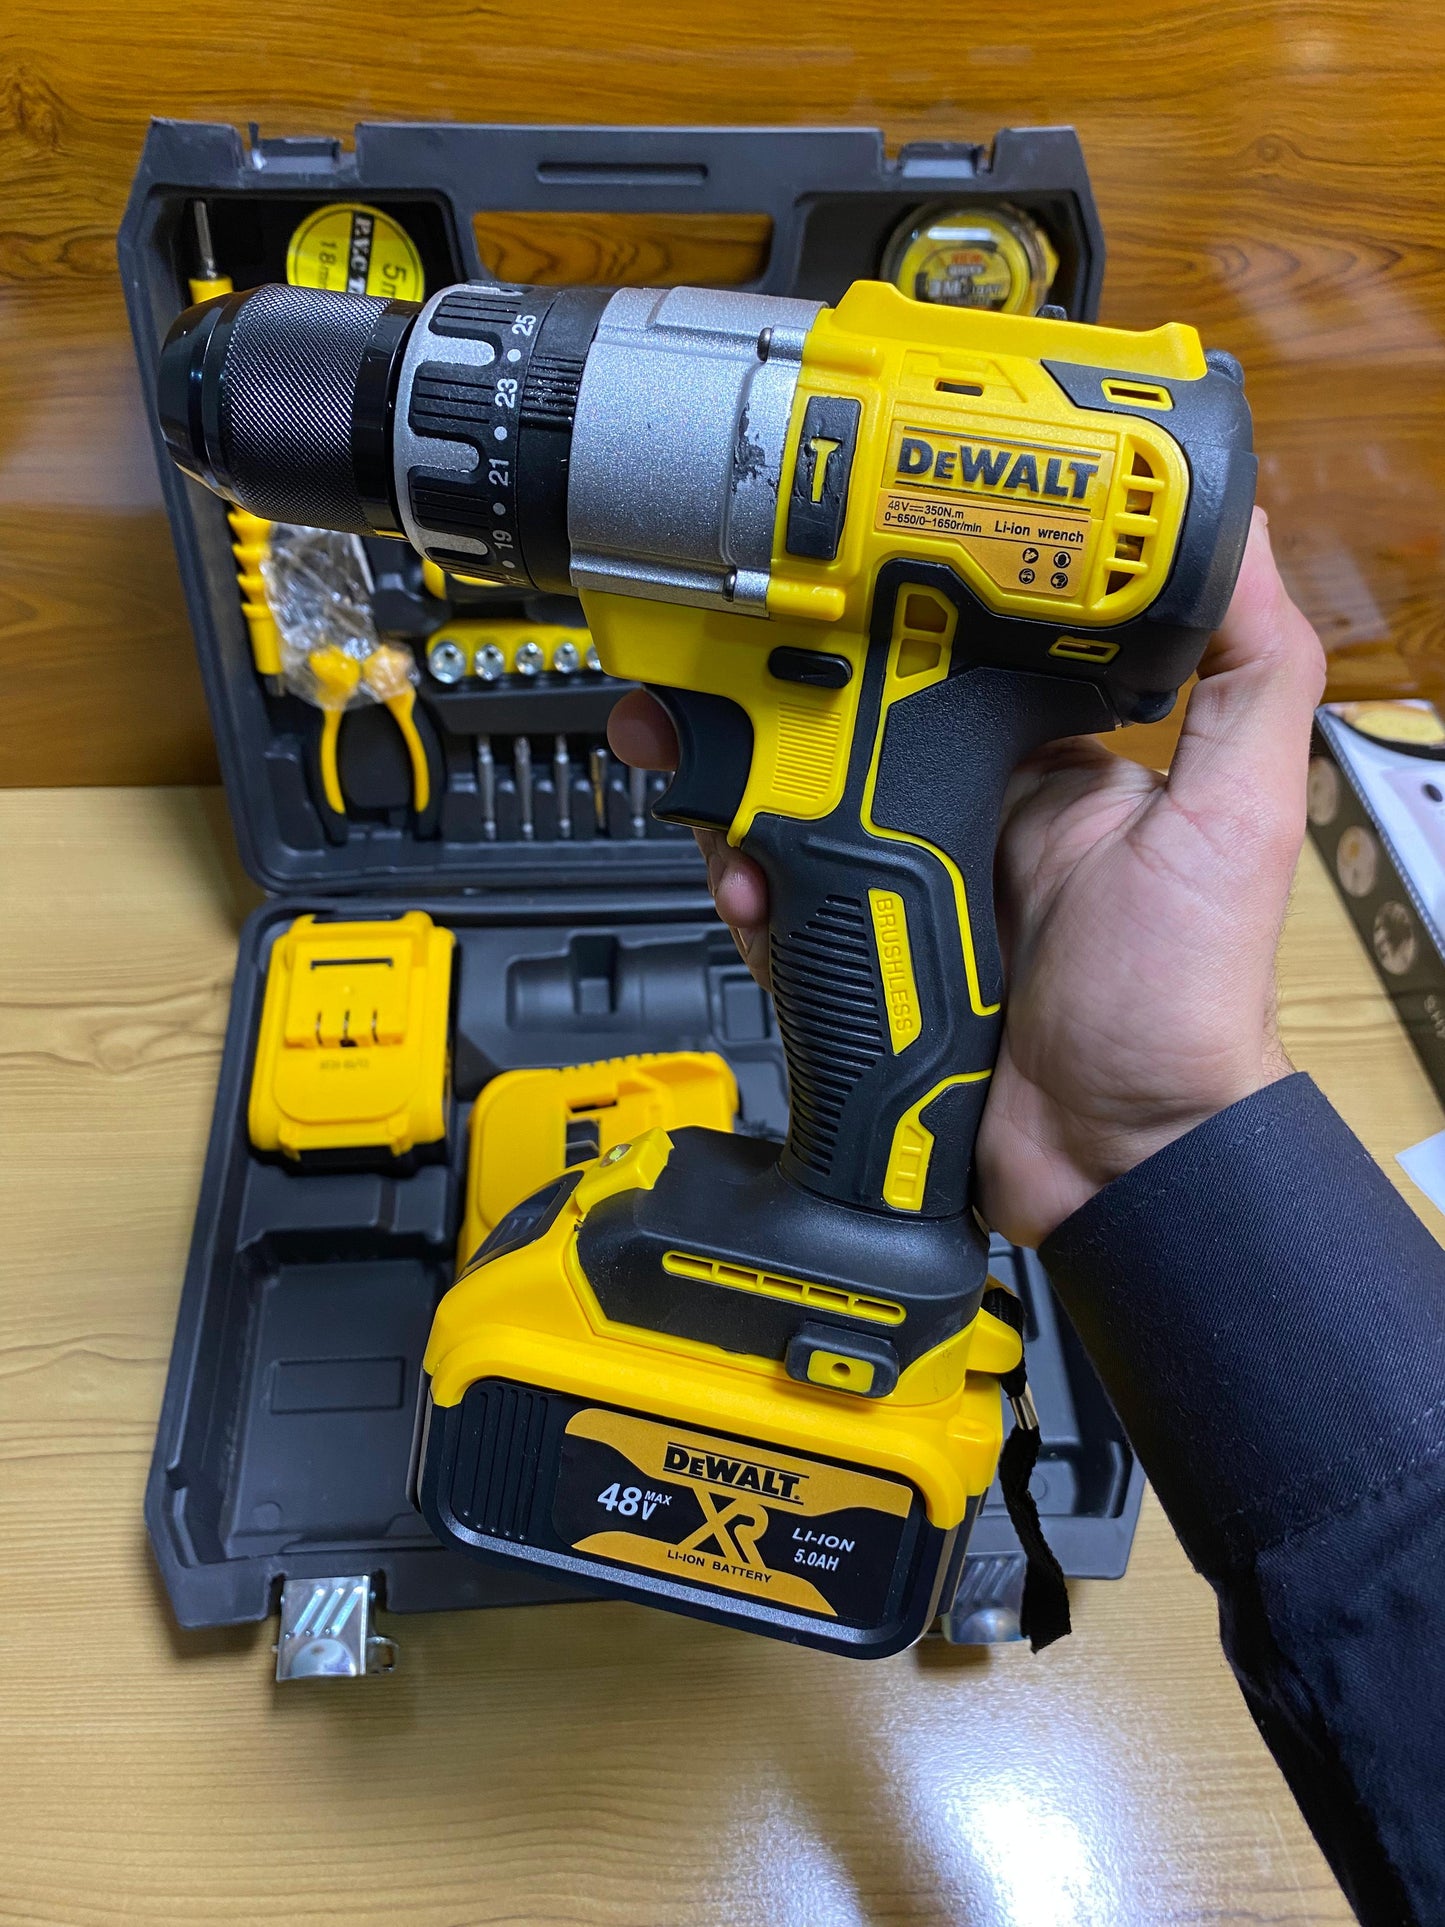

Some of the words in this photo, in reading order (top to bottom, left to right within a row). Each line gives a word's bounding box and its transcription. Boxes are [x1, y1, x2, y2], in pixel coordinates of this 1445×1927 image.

[511, 314, 537, 336] 25
[495, 378, 518, 409] 23
[488, 458, 510, 487] 21
[492, 529, 514, 549] 19
[994, 520, 1031, 536] Li-ion
[1037, 528, 1084, 543] wrench
[876, 897, 913, 1032] BRUSHLESS
[644, 1490, 673, 1506] MAX
[792, 1527, 856, 1553] LI-ION
[667, 1549, 705, 1567] LI-ION
[712, 1560, 773, 1583] BATTERY
[793, 1548, 840, 1573] 5.0AH
